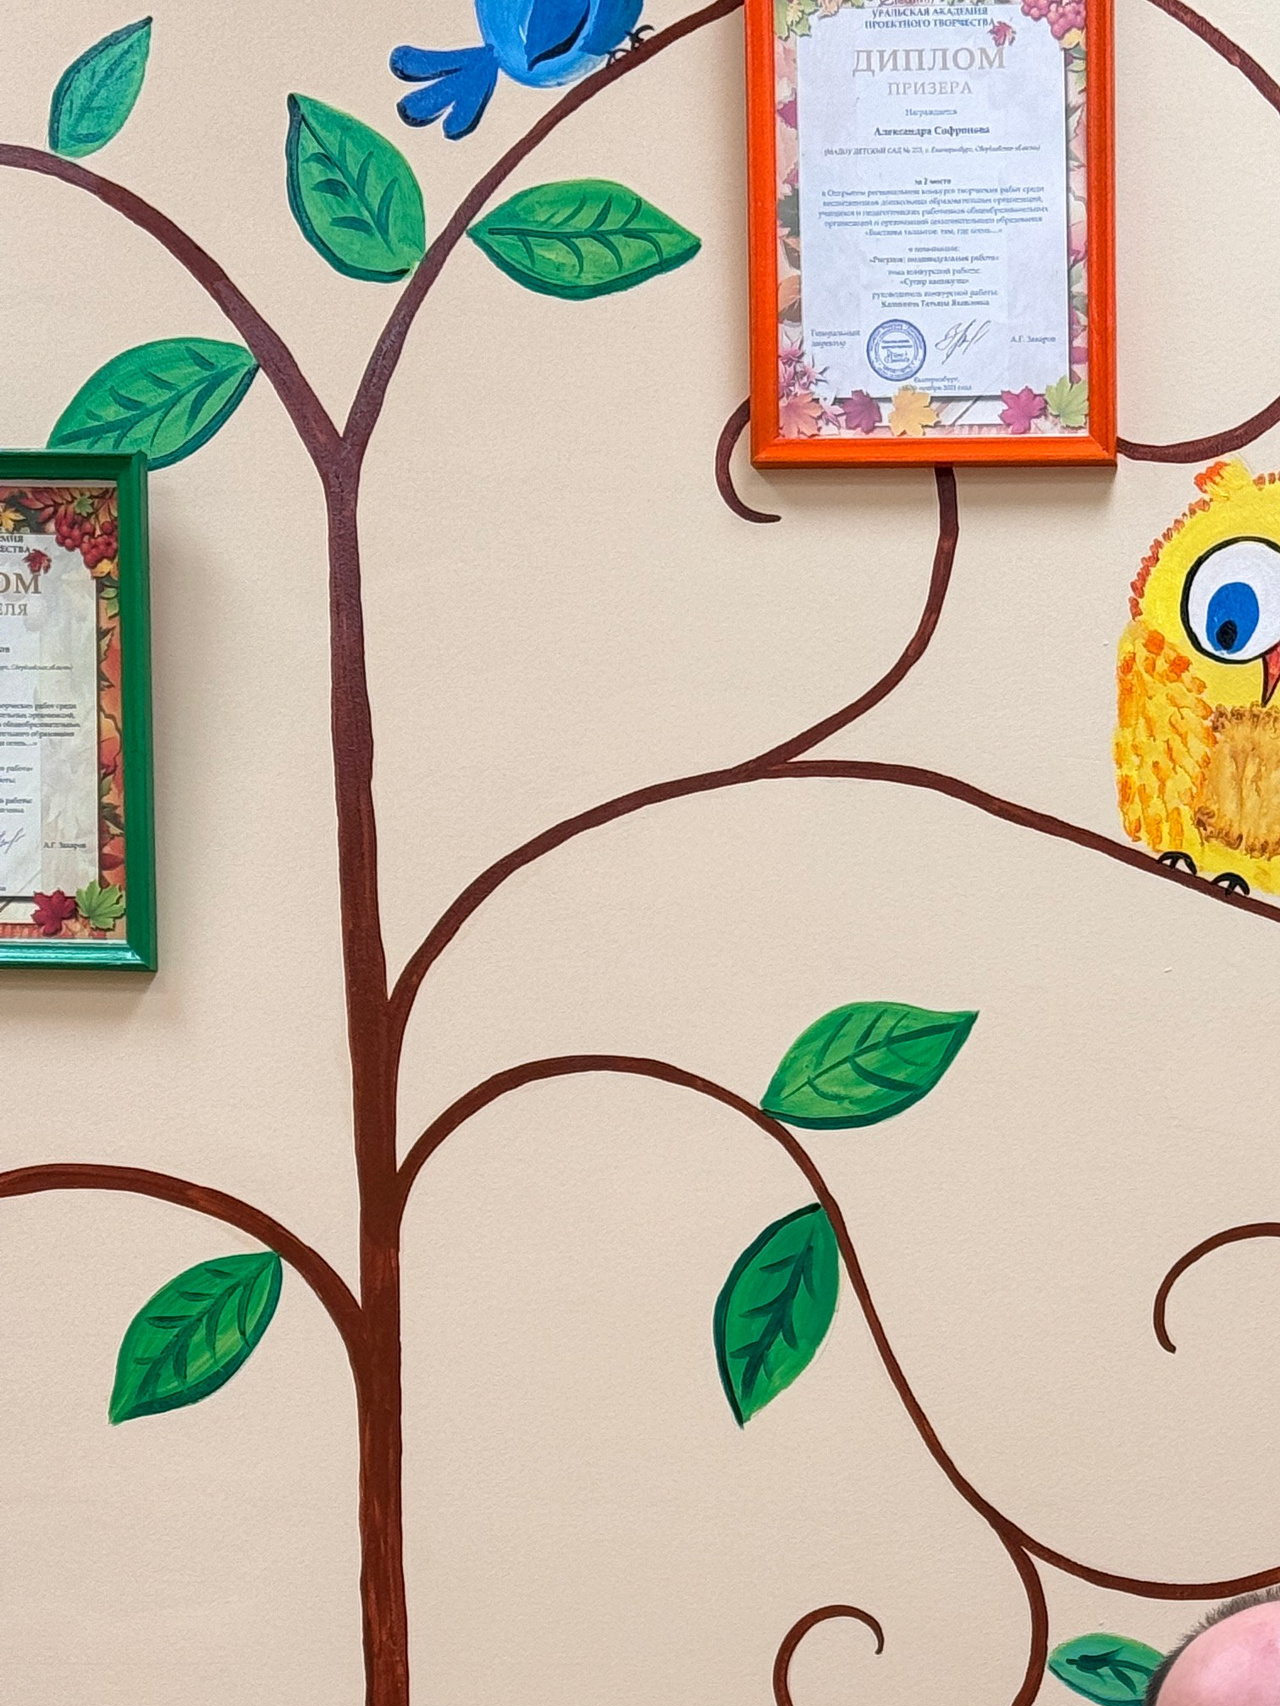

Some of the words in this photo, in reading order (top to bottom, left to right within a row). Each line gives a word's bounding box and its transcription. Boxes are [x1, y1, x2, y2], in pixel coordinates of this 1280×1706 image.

[872, 8, 930, 19] УРАЛЬСКАЯ
[932, 7, 989, 17] АКАДЕМИЯ
[864, 19, 931, 29] ПРОЕКТНОГО
[852, 46, 1006, 77] ДИПЛОМ
[887, 81, 973, 96] ПРИЗЕРА
[0, 603, 28, 616] ЛЯ
